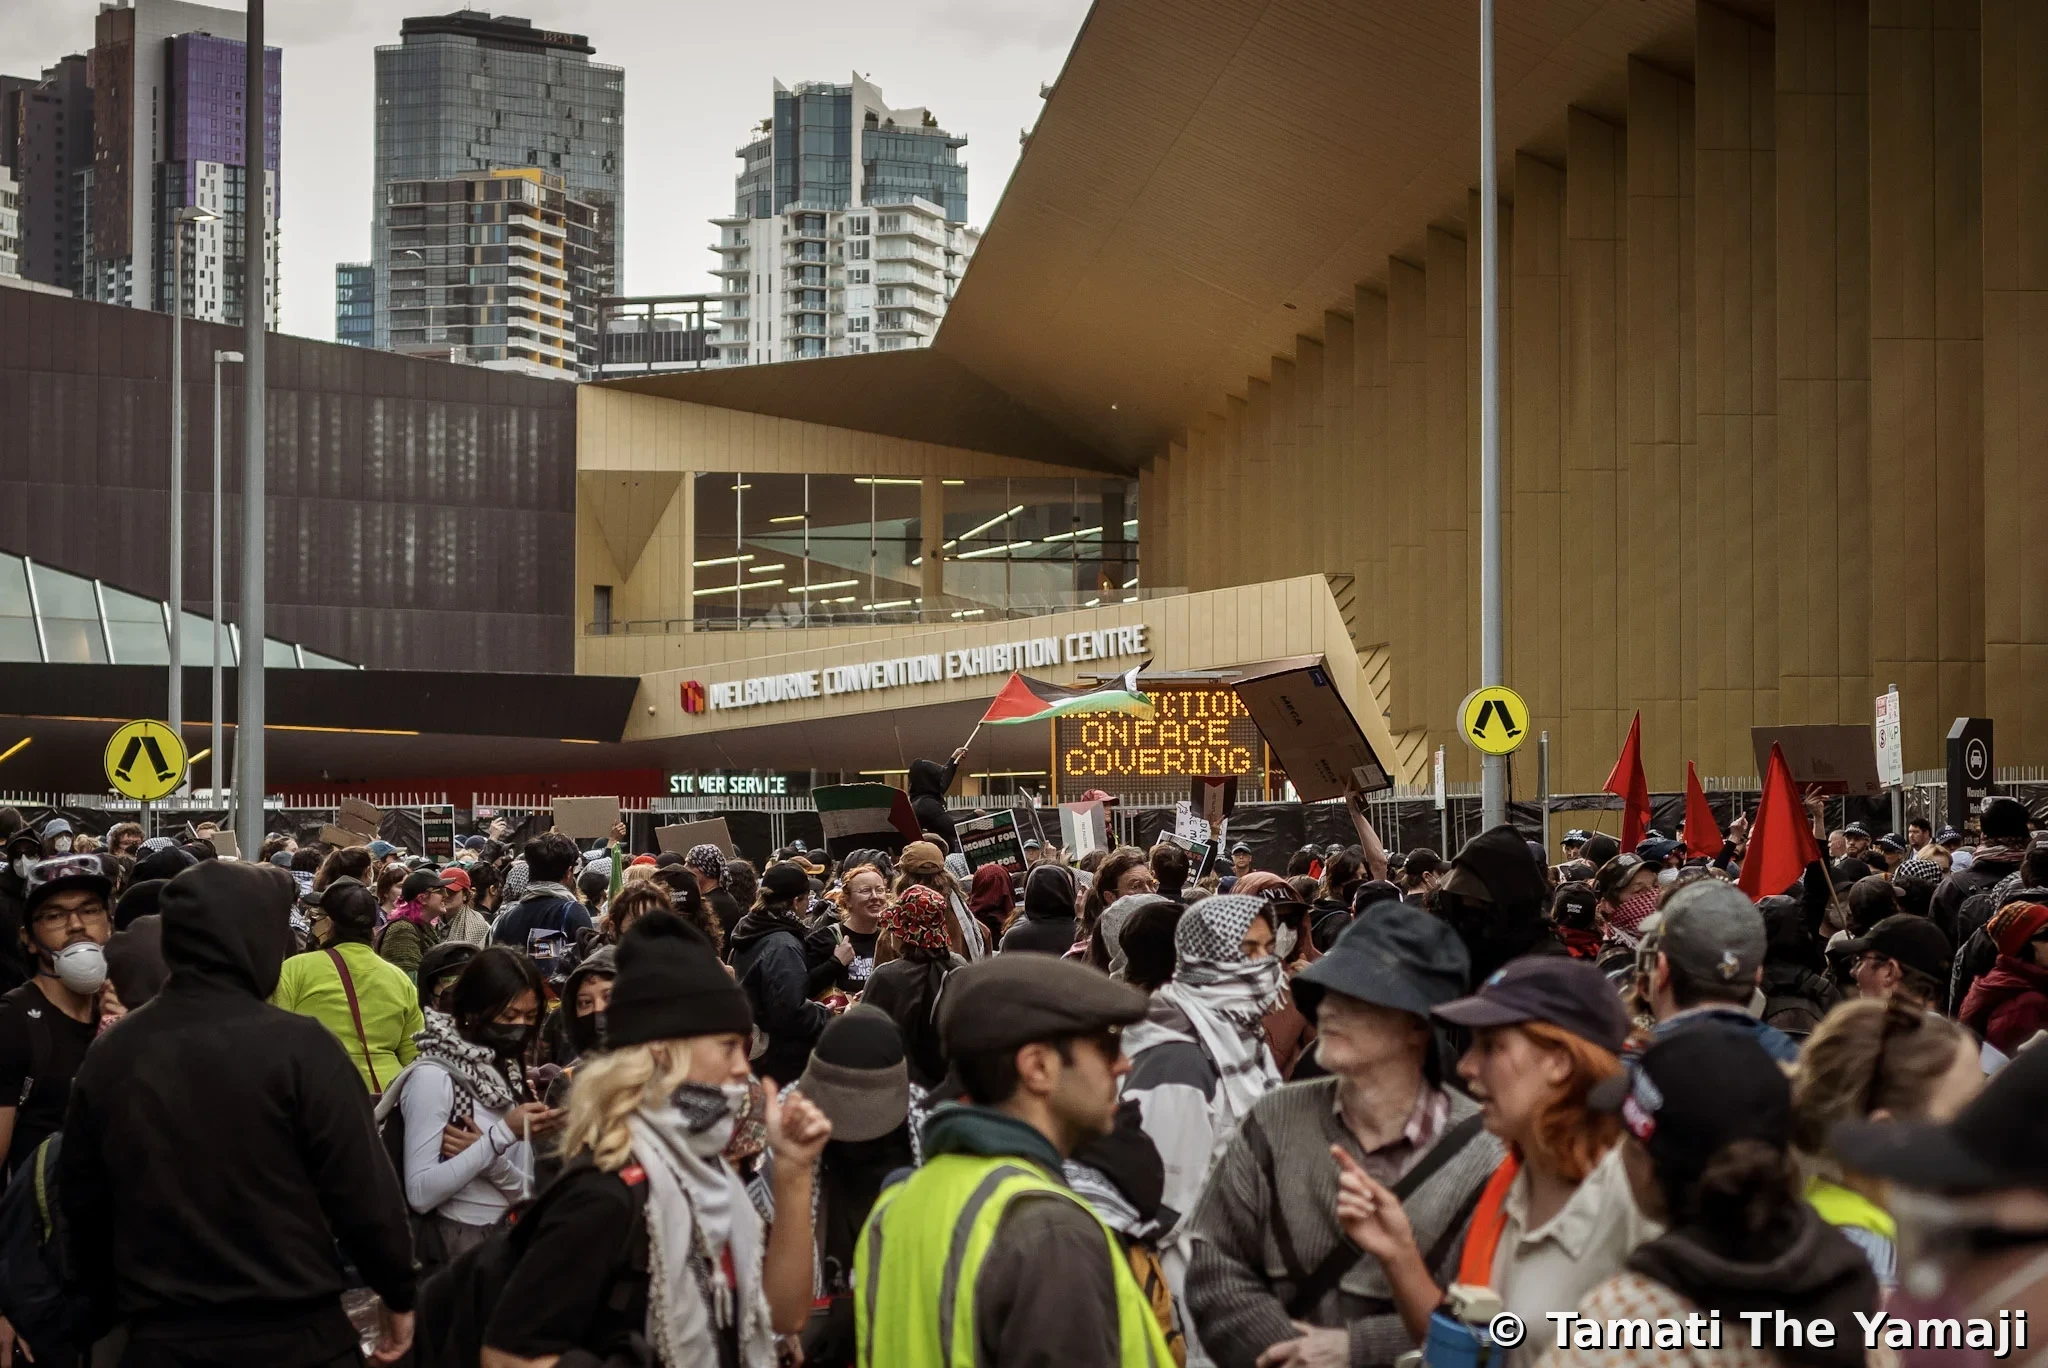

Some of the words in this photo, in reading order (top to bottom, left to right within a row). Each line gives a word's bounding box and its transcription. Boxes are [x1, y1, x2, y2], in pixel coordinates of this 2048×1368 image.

[709, 669, 821, 711] MELBOURNE
[823, 654, 942, 695] CONVENTION
[945, 635, 1061, 679] EXHIBITION
[1065, 623, 1149, 662] CENTRE
[1081, 720, 1128, 747] ON
[1134, 719, 1230, 747] FACE
[1065, 747, 1251, 776] COVERING
[729, 776, 787, 794] SERVICE
[963, 835, 996, 852] MONEY
[997, 831, 1017, 843] FOR
